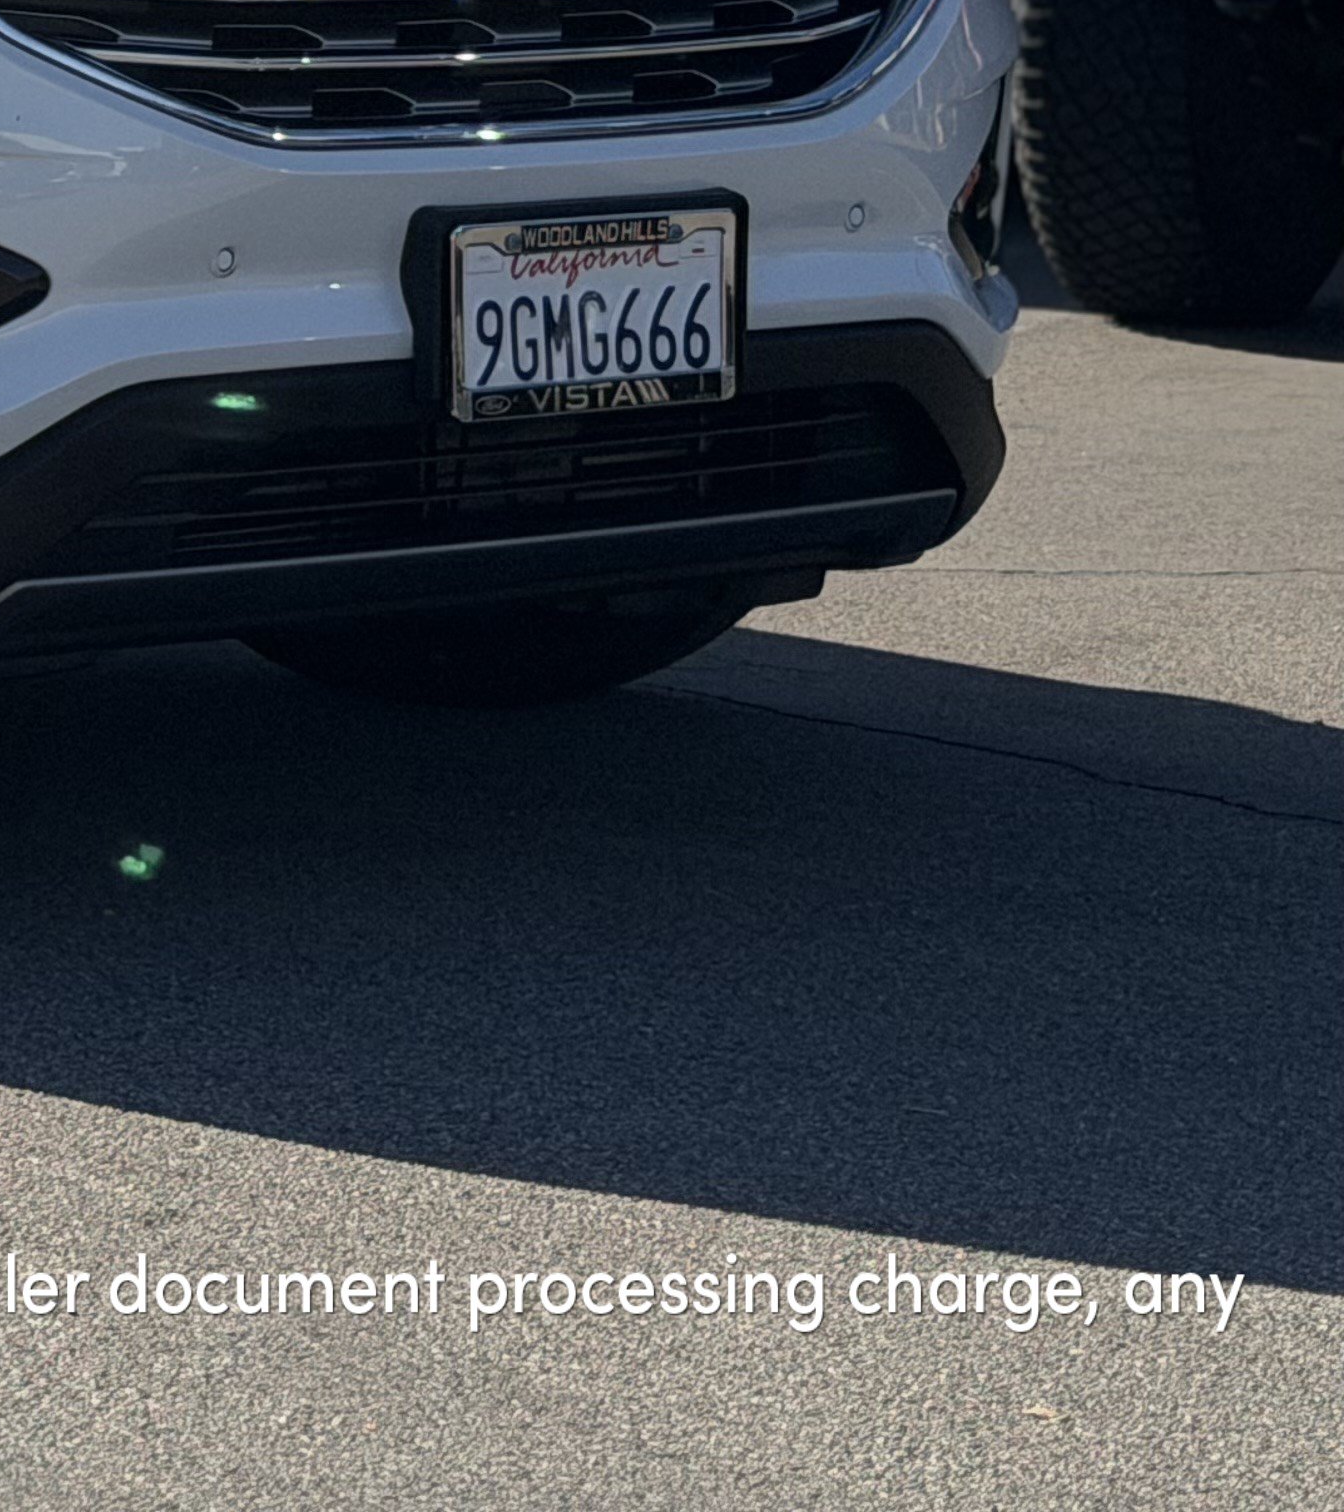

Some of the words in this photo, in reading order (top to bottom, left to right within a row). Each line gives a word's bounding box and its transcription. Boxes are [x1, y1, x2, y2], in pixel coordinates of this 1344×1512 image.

[522, 222, 618, 249] WOODLAND
[621, 219, 669, 244] HILLS
[511, 244, 680, 288] California
[476, 282, 712, 386] 9GMG666
[527, 379, 638, 412] VISTA
